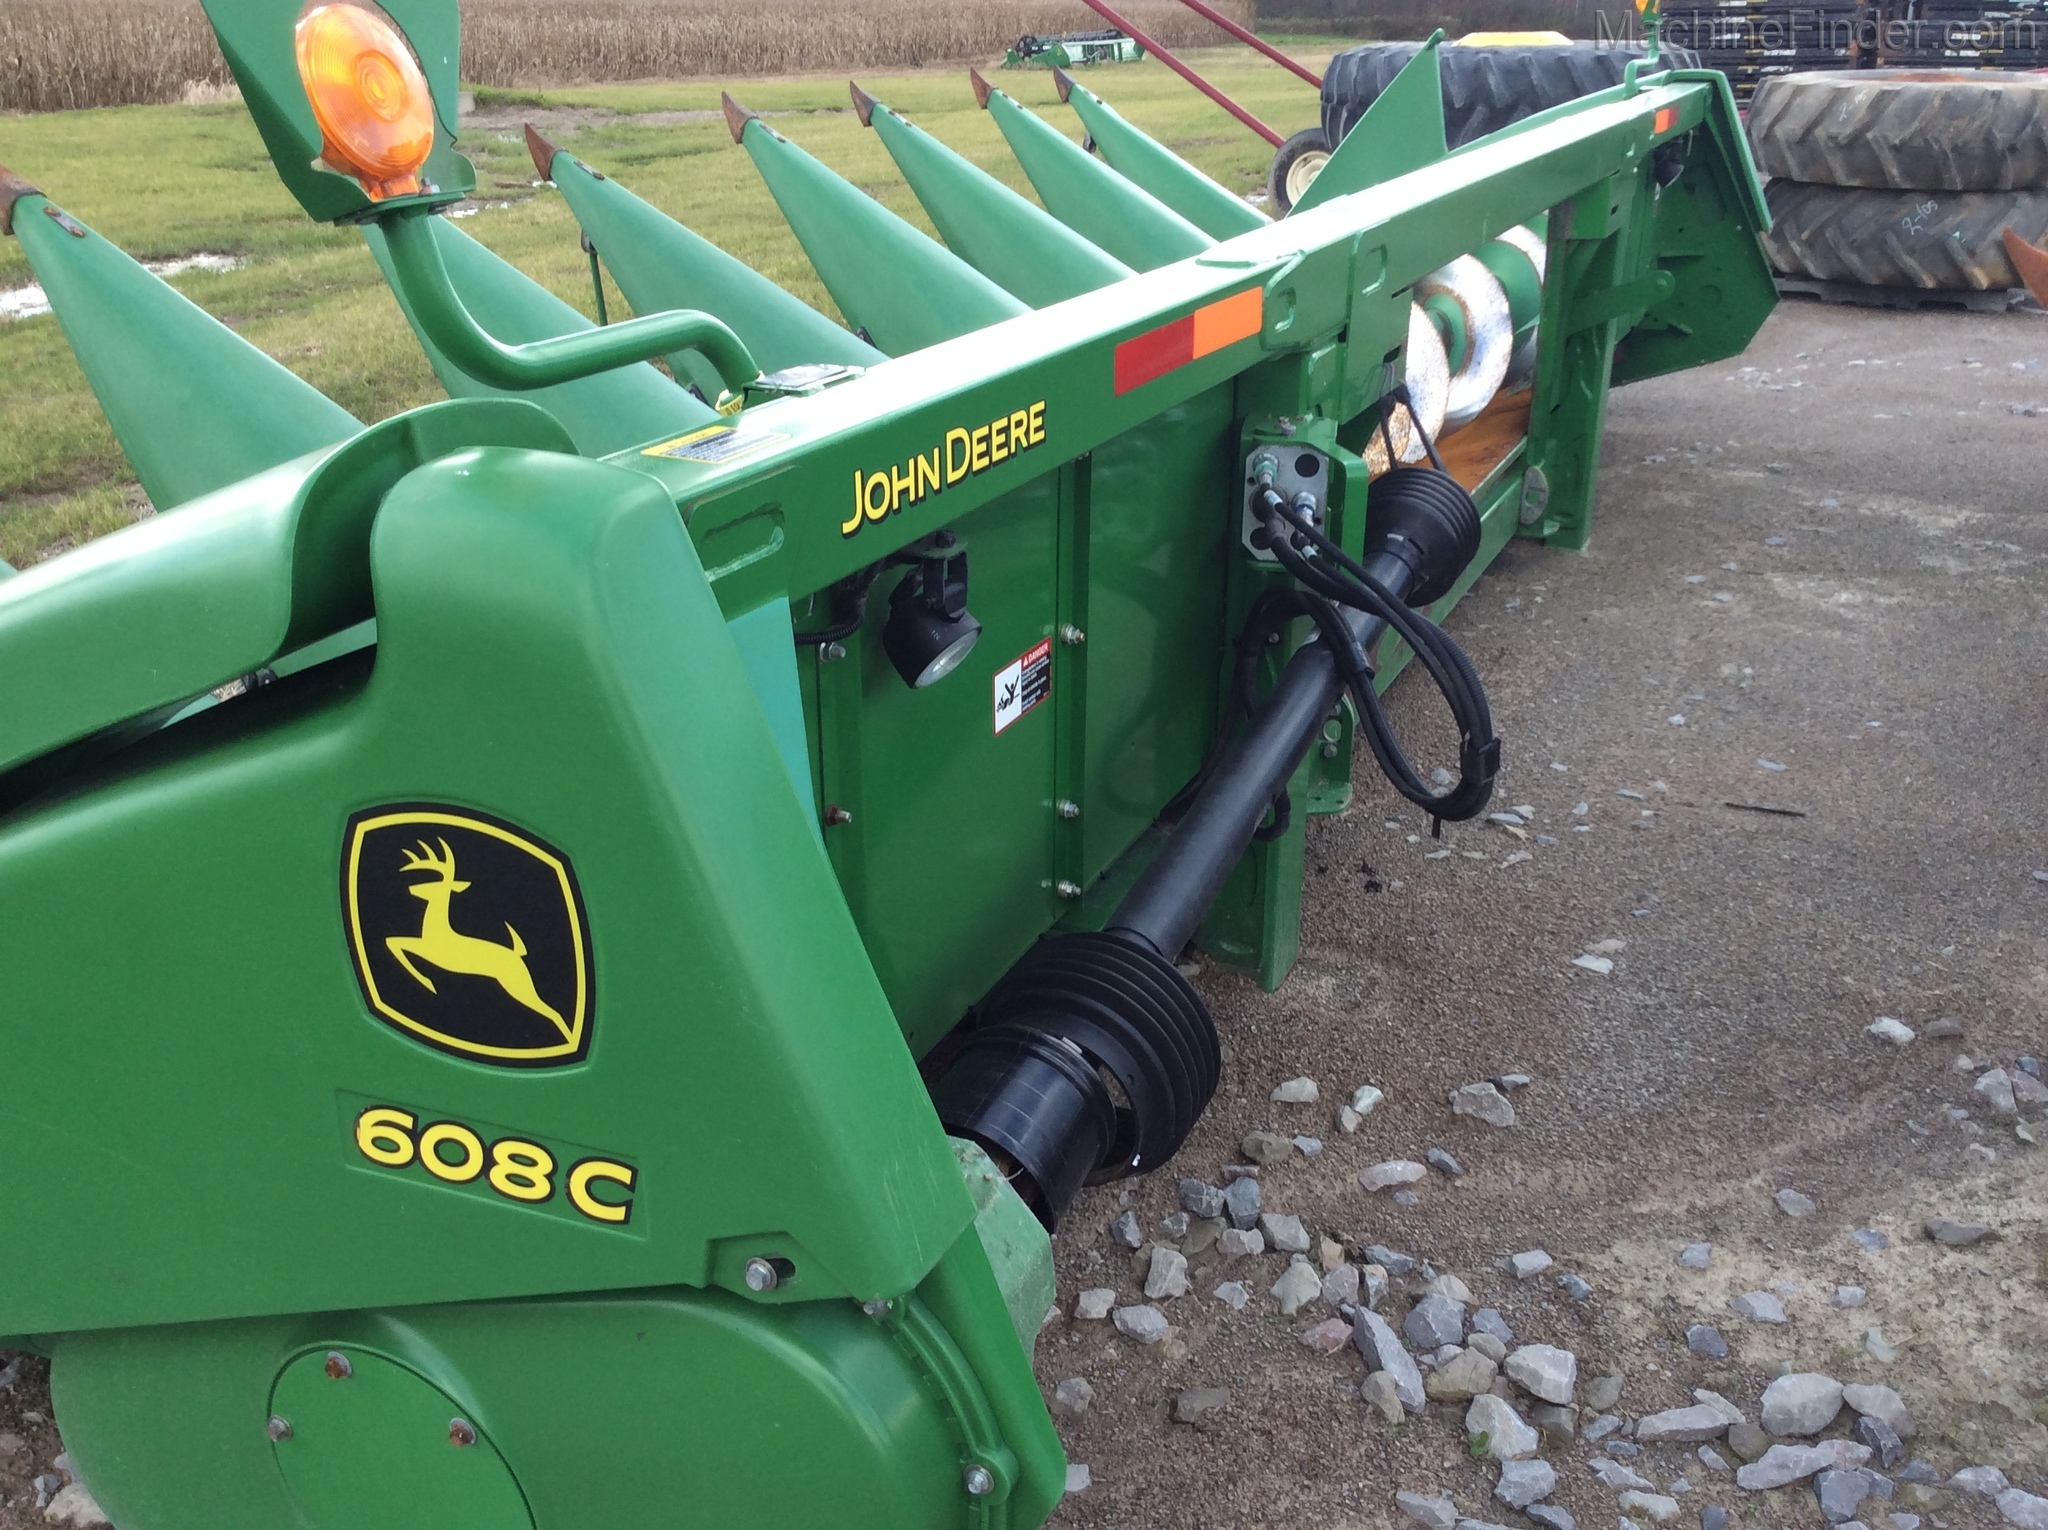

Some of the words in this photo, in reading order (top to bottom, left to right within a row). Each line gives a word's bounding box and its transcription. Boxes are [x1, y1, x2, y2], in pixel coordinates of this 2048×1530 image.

[841, 446, 940, 536] JOHN
[945, 400, 1045, 487] DEERE
[1028, 642, 1049, 664] DANGER
